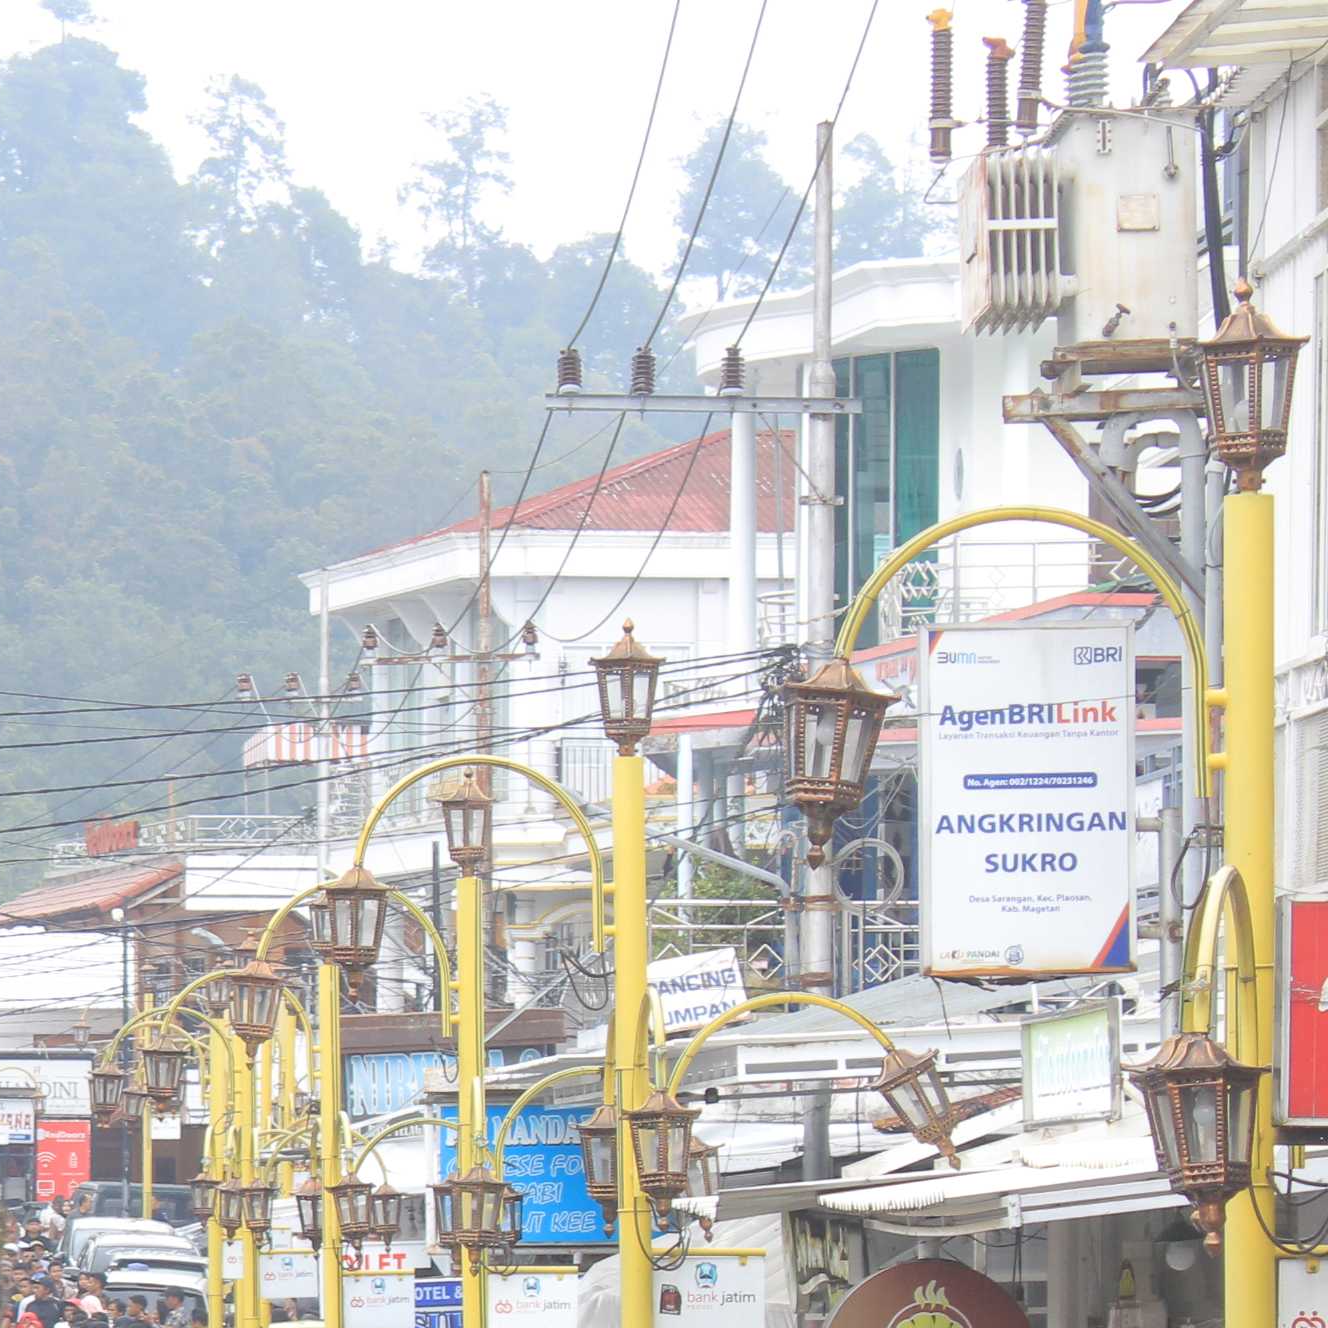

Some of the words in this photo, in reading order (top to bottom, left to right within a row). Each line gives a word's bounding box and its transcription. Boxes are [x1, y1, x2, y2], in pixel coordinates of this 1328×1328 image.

[1093, 646, 1123, 663] BRI
[939, 701, 1117, 731] AgenBRILink
[936, 811, 1127, 834] ANGKRINGAN
[985, 852, 1078, 873] SUKRO
[415, 1285, 452, 1300] OTEL
[686, 1290, 719, 1303] bank
[720, 1290, 756, 1306] jatim
[515, 1300, 542, 1310] bank
[543, 1300, 571, 1312] jatim
